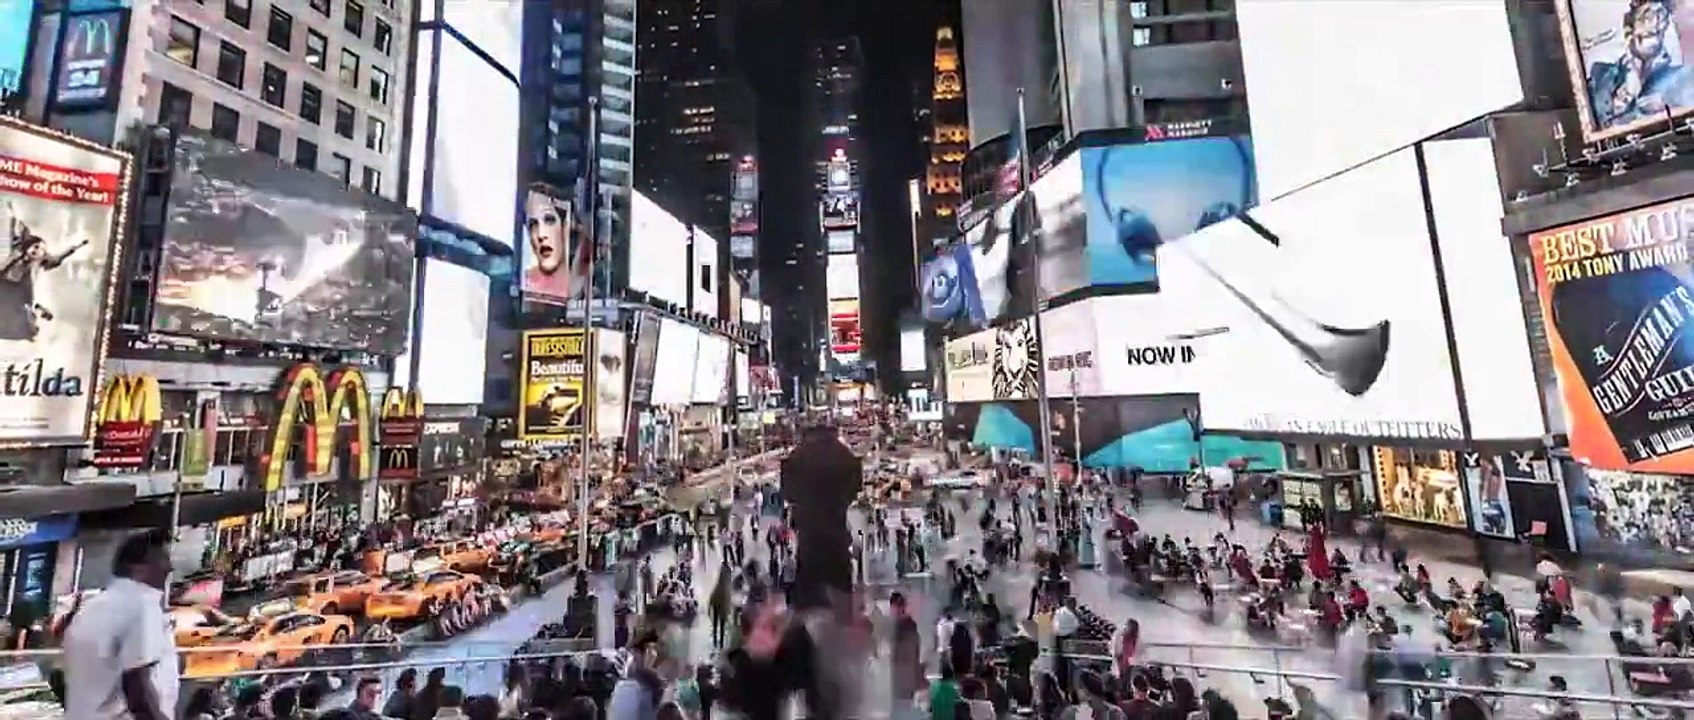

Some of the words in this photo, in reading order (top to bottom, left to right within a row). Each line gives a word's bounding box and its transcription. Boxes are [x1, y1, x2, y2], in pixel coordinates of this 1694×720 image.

[33, 182, 49, 193] of
[51, 184, 74, 198] the
[77, 187, 109, 203] Year!
[1540, 224, 1615, 264] BEST
[1545, 258, 1583, 283] 2014
[1582, 252, 1625, 277] TONY
[1127, 345, 1176, 365] NOW
[1592, 345, 1614, 366] A
[1593, 285, 1694, 415] GENTLEMAN'S
[530, 358, 585, 376] Beautifu
